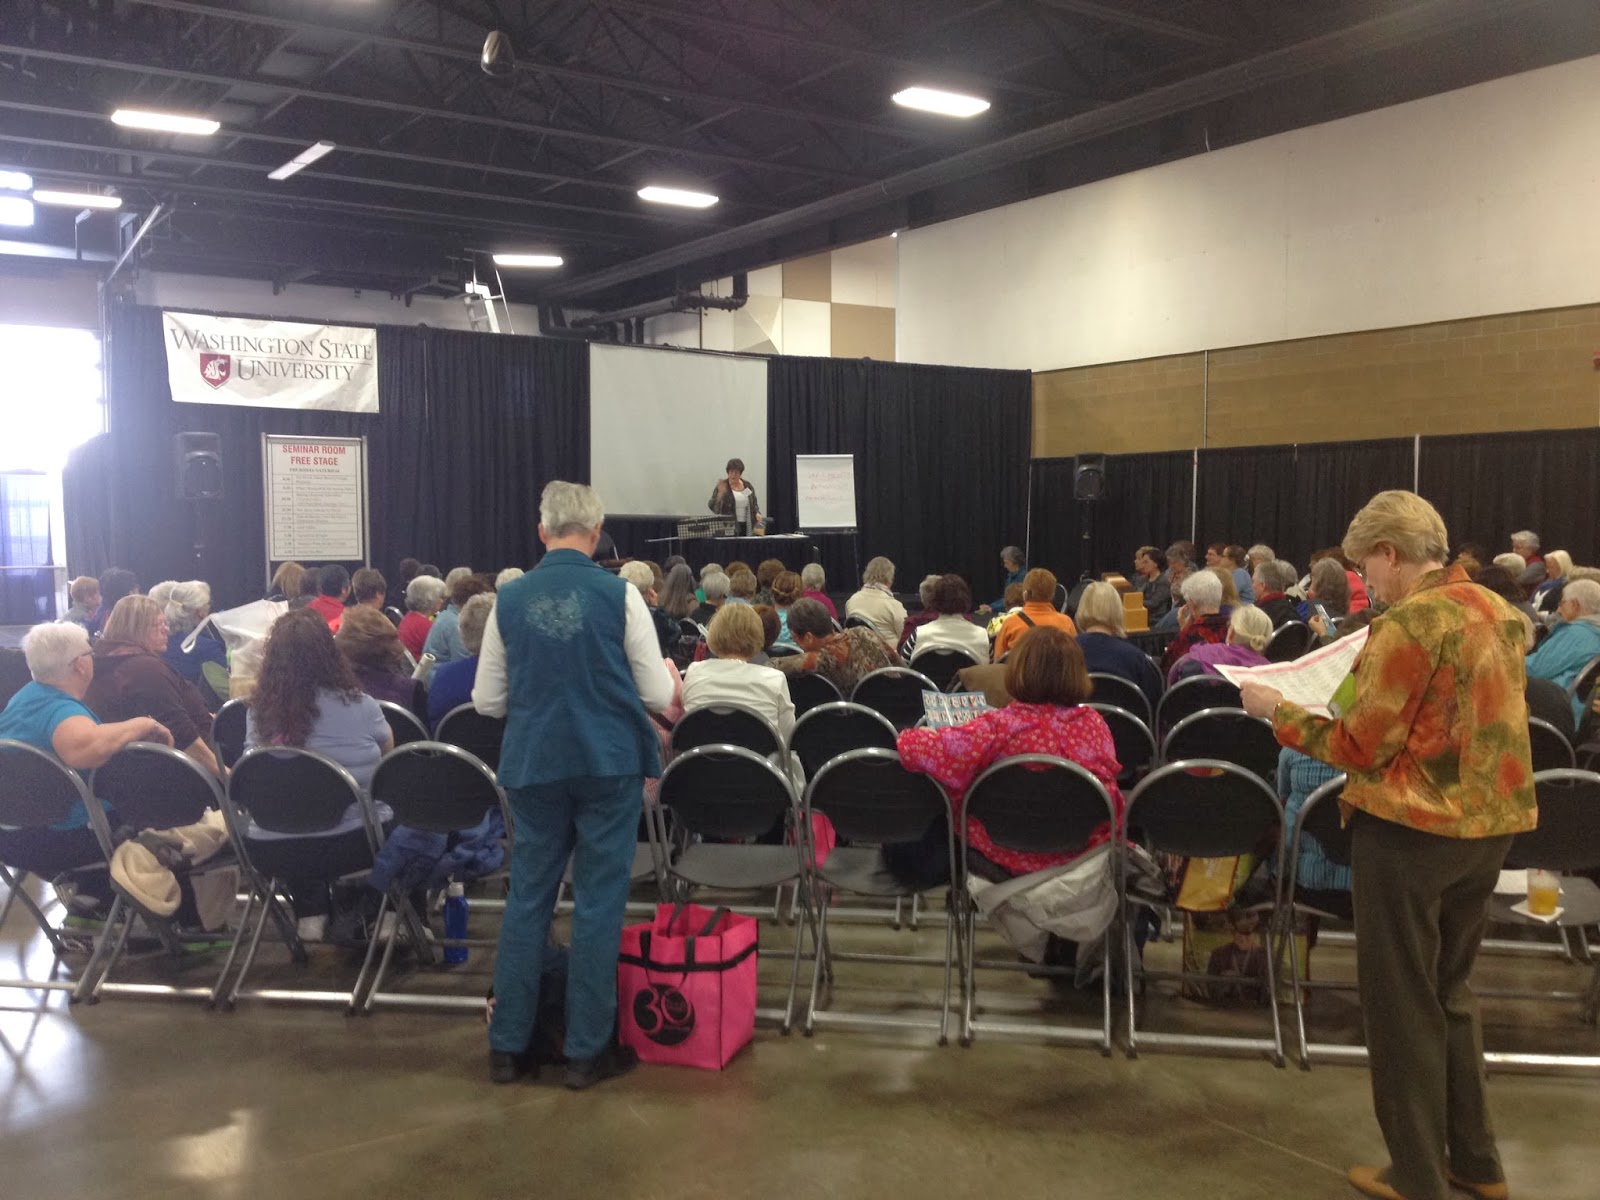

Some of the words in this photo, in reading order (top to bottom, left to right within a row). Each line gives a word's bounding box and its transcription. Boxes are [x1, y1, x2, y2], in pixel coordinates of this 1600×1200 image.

[282, 444, 320, 454] SEMINAR
[322, 445, 346, 455] ROOM
[290, 456, 311, 465] FREE
[313, 457, 339, 466] STAGE
